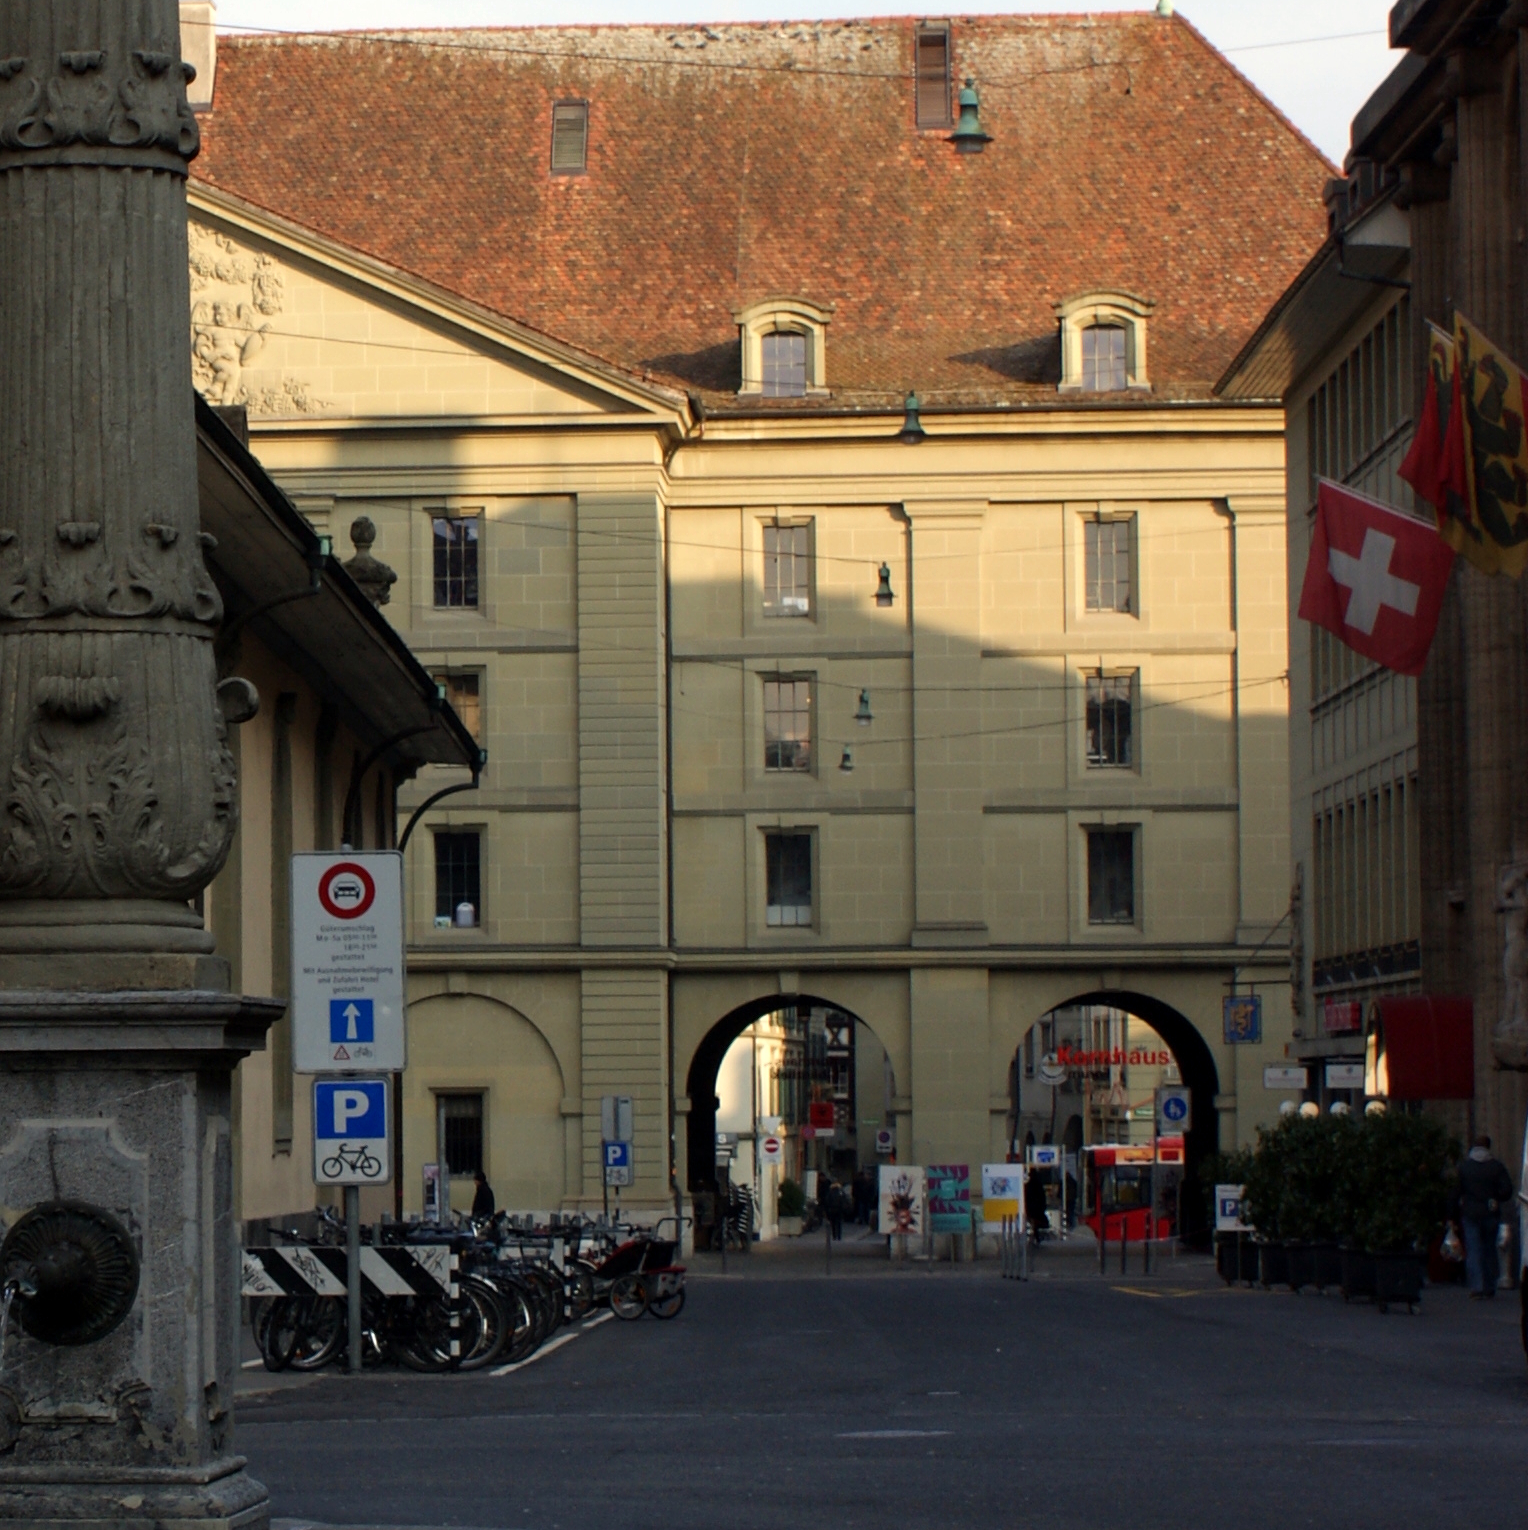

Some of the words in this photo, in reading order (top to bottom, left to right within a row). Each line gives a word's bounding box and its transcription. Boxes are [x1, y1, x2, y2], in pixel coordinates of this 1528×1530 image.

[1056, 1046, 1170, 1066] Kornhaus
[333, 1090, 369, 1134] P
[607, 1145, 622, 1166] P
